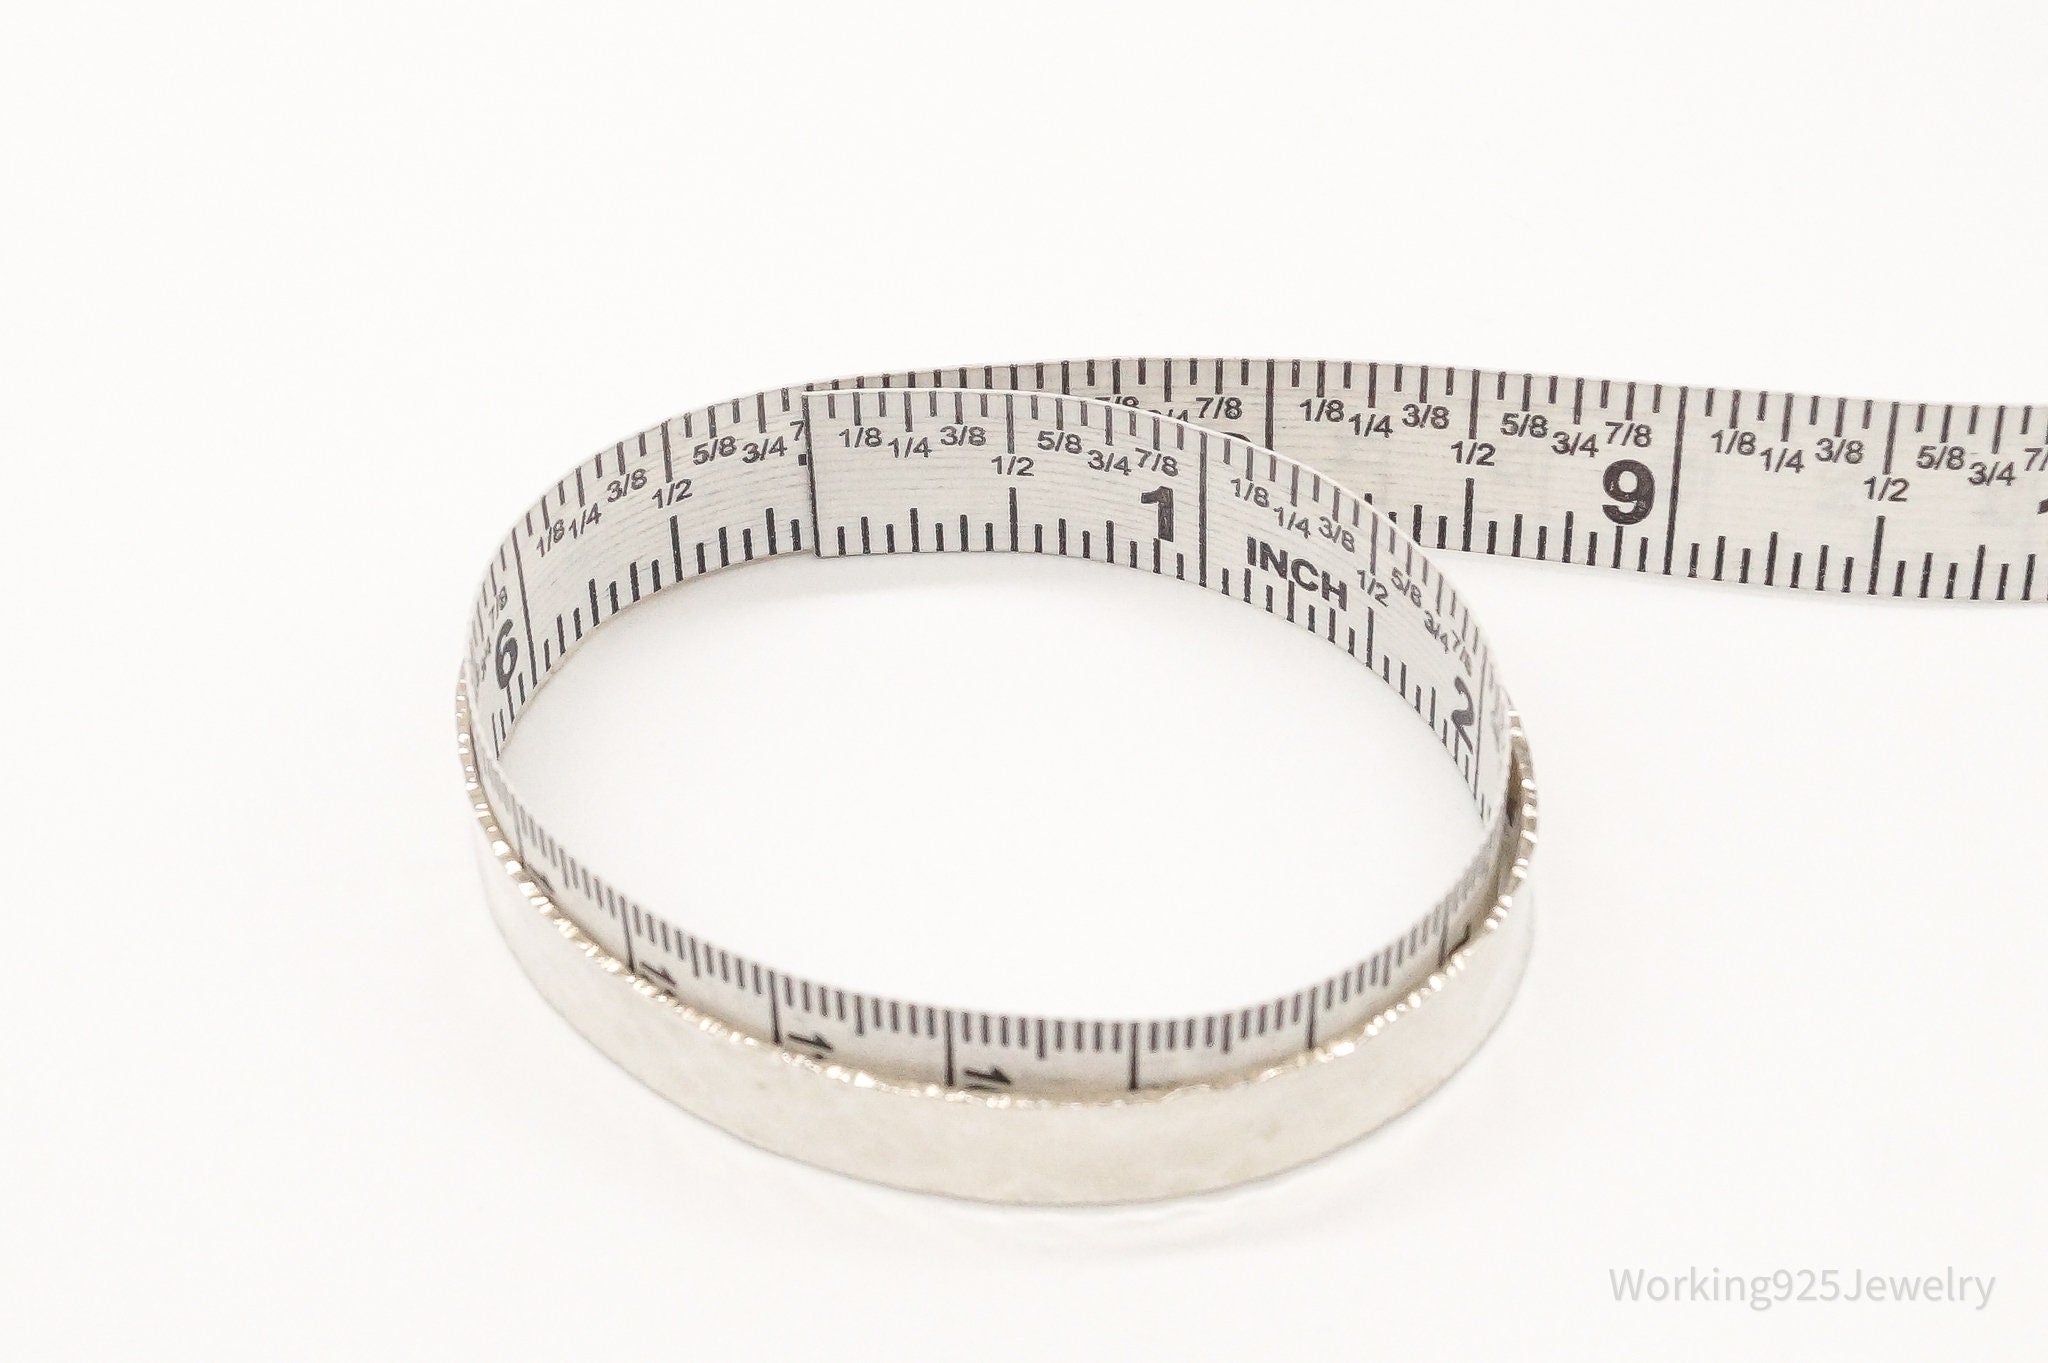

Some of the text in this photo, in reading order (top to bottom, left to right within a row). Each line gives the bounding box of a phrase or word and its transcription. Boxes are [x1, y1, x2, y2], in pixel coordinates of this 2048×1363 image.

[1195, 395, 1244, 421] 7/8
[1299, 398, 1346, 423] 1/8
[1401, 402, 1451, 430] 3/8
[838, 426, 883, 450] 1/8
[939, 424, 987, 447] 3/8
[1348, 412, 1394, 439] 1/4
[1500, 412, 1548, 439] 5/8
[1605, 420, 1653, 448] 7/8
[692, 435, 738, 466] 5/8
[741, 435, 788, 464] 3/4
[887, 437, 932, 459] 1/4
[1036, 430, 1083, 455] 5/8
[1450, 440, 1496, 467] 1/2
[1550, 431, 1600, 458] 3/4
[1710, 429, 1757, 456] 1/8
[1815, 437, 1865, 464] 3/8
[990, 455, 1035, 477] 1/2
[1087, 450, 1132, 476] 3/4
[1134, 448, 1180, 477] 7/8
[1759, 448, 1806, 474] 1/4
[1916, 445, 1966, 471] 5/8
[605, 468, 648, 503] 3/8
[1967, 461, 2016, 487] 3/4
[651, 478, 694, 509] 1/2
[1230, 477, 1270, 509] 1/8
[1602, 458, 1656, 526] 9
[1863, 475, 1911, 502] 1/2
[567, 502, 603, 540] 1/4
[1140, 485, 1174, 542] 1
[1273, 505, 1311, 540] 1/4
[535, 517, 566, 559] 1/8
[1317, 514, 1356, 554] 3/8
[1246, 535, 1348, 612] INCH
[1355, 568, 1389, 607] 1/2
[1390, 566, 1422, 608] 5/8
[494, 618, 519, 690] 6
[1450, 675, 1475, 755] 2
